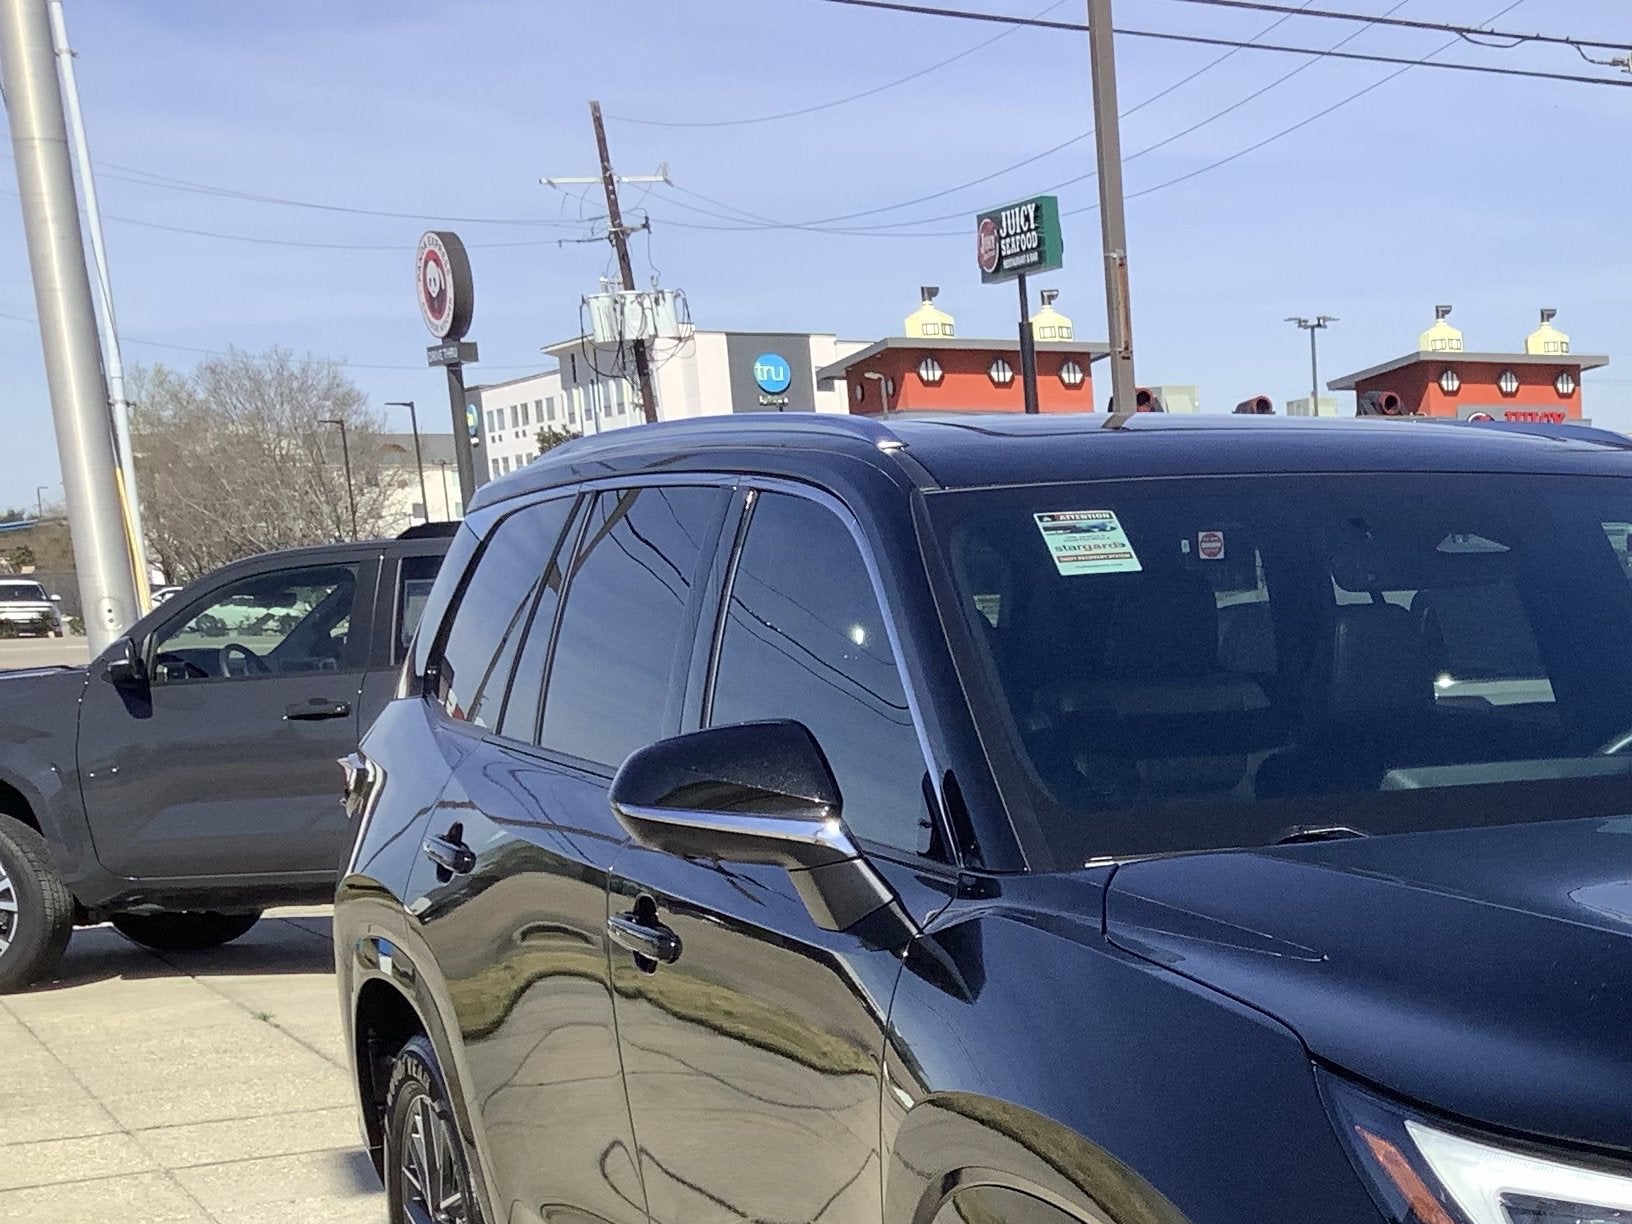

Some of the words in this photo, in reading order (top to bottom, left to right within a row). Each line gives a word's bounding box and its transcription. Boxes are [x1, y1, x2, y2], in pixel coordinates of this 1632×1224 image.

[999, 203, 1036, 238] JUICY
[1000, 231, 1038, 256] SEAFOOD
[754, 362, 784, 381] tru
[1059, 513, 1111, 521] ATTENTION
